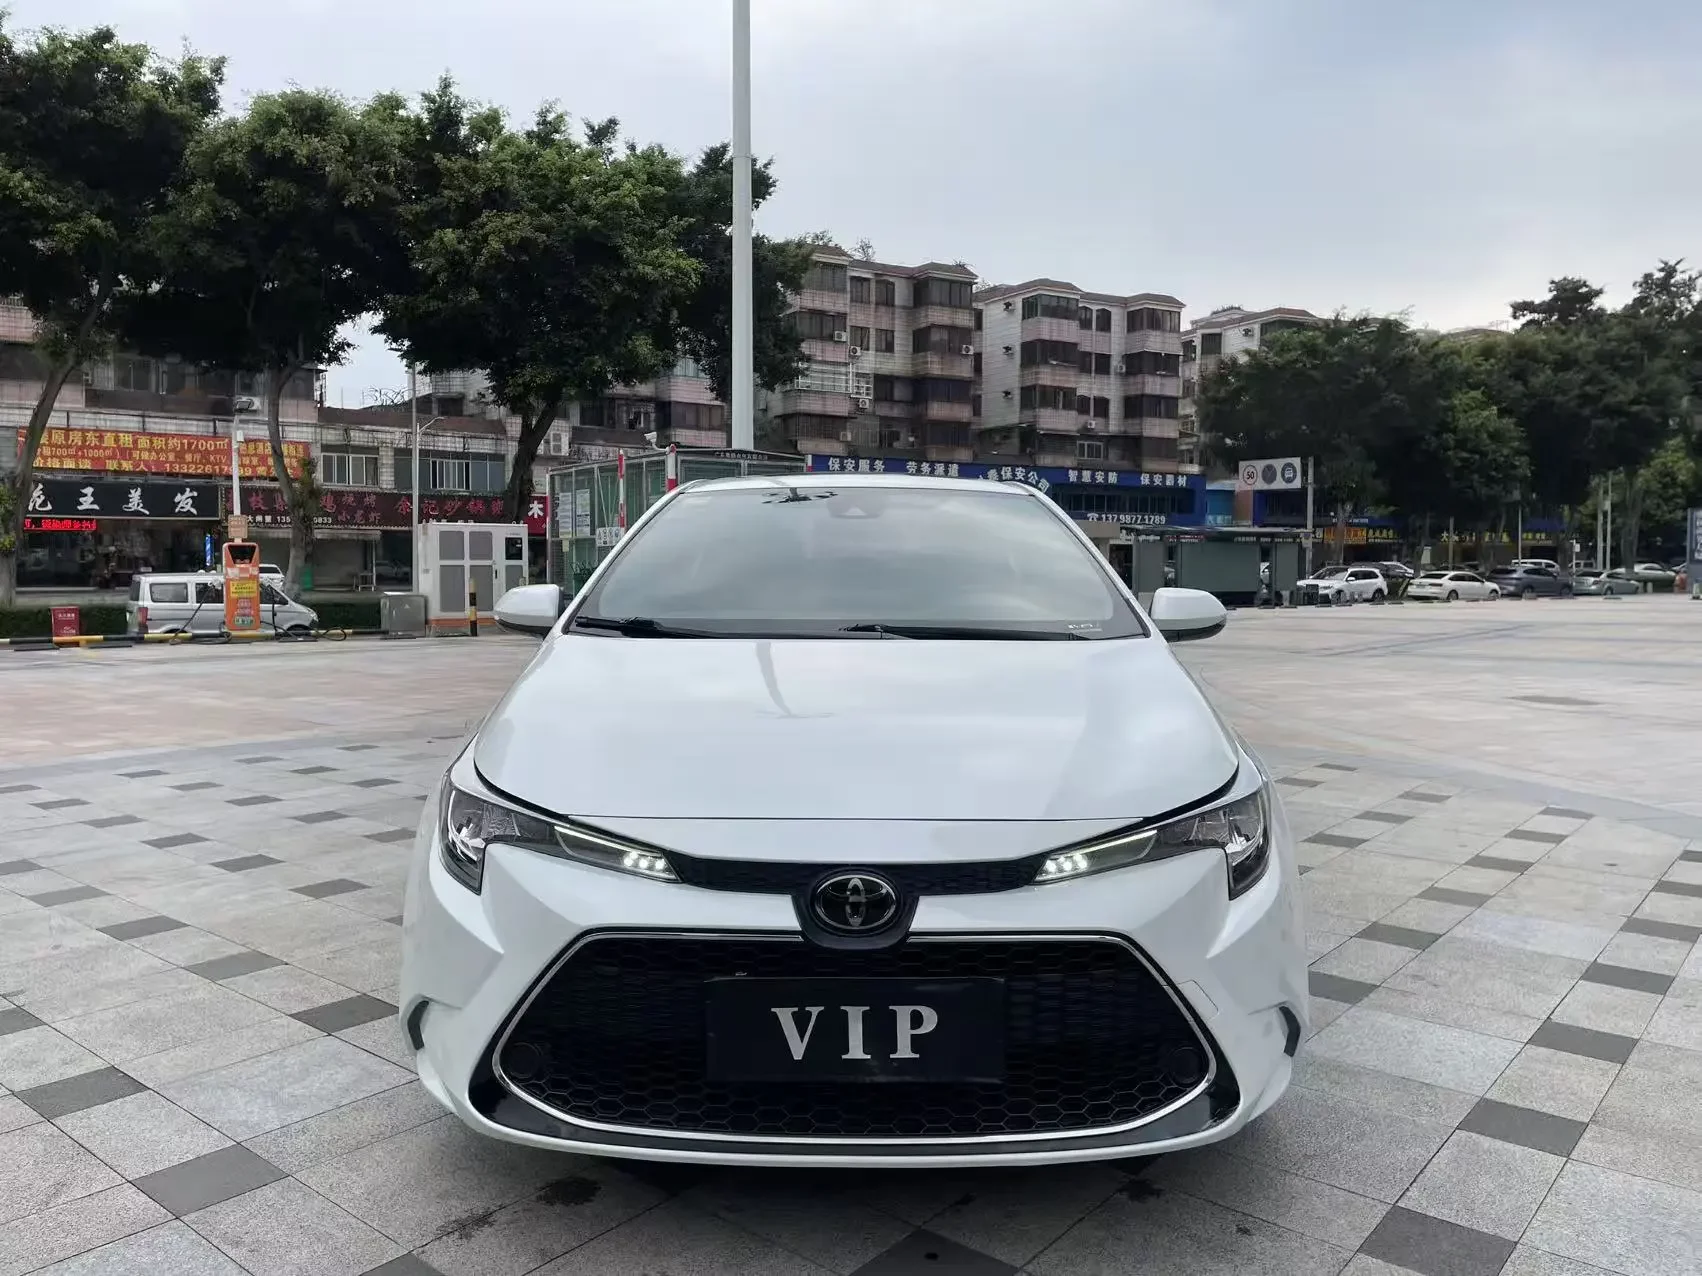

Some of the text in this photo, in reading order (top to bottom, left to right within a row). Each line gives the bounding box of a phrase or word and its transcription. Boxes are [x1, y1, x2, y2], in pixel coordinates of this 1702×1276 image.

[828, 457, 959, 477] 保安服务 劳务派遣
[1246, 471, 1255, 480] 50
[1068, 469, 1188, 487] 智慧安防 保安器材
[771, 1005, 938, 1060] VIP
